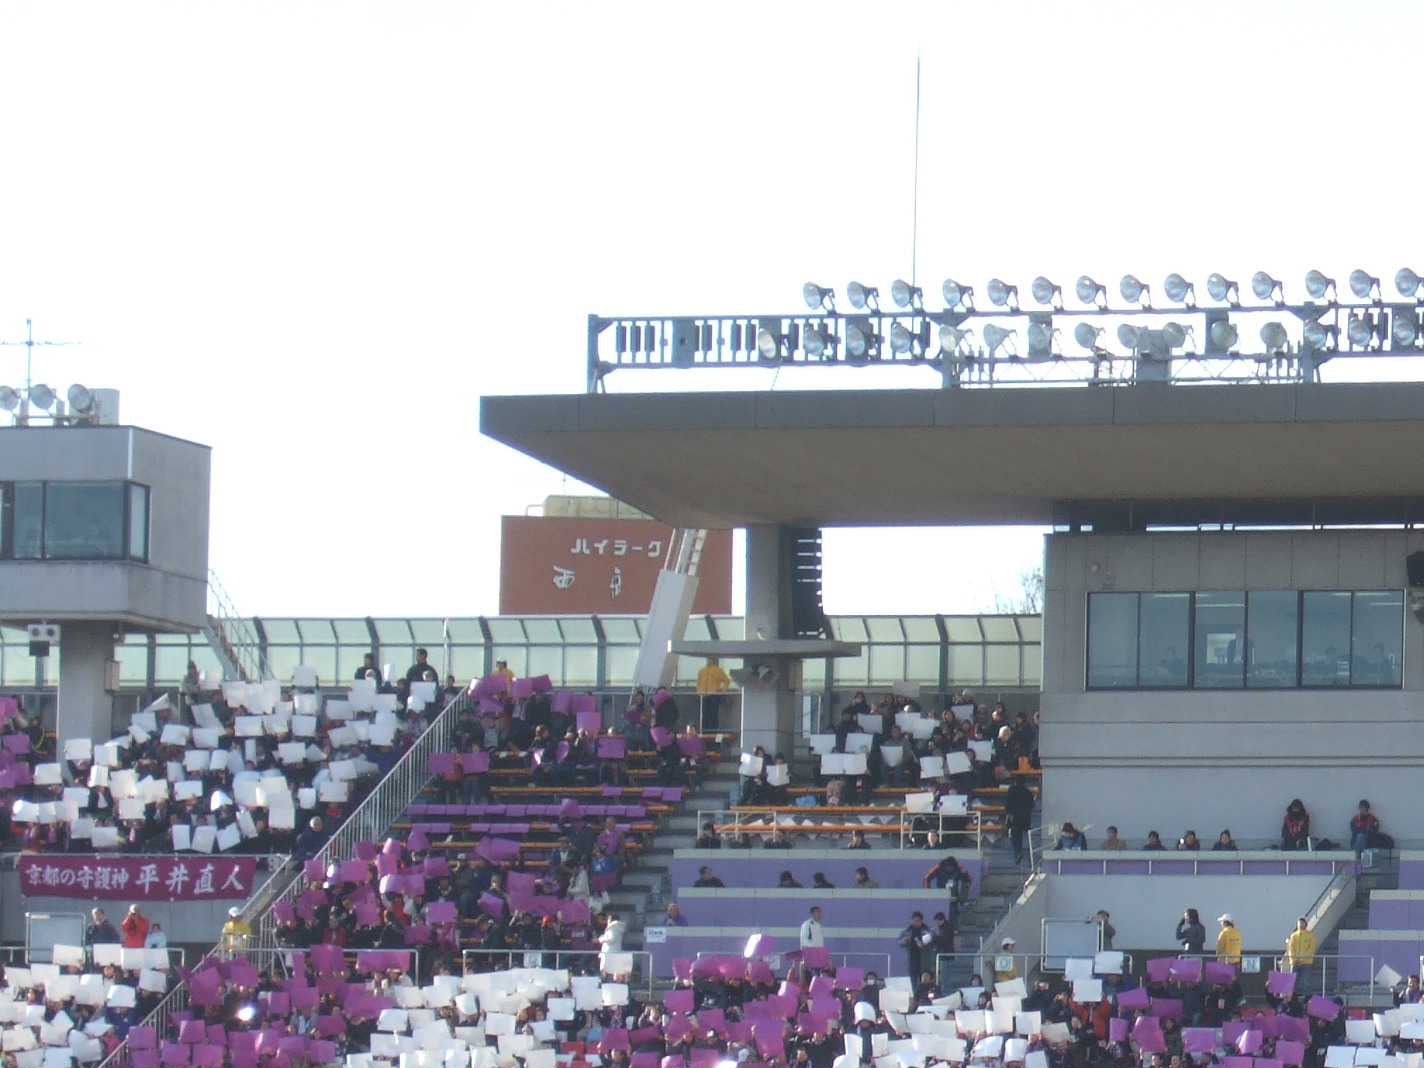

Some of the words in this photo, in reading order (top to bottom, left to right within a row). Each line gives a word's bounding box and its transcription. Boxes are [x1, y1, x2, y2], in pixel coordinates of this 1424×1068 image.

[25, 864, 129, 890] 京都の守護神
[135, 863, 245, 896] 平井直人
